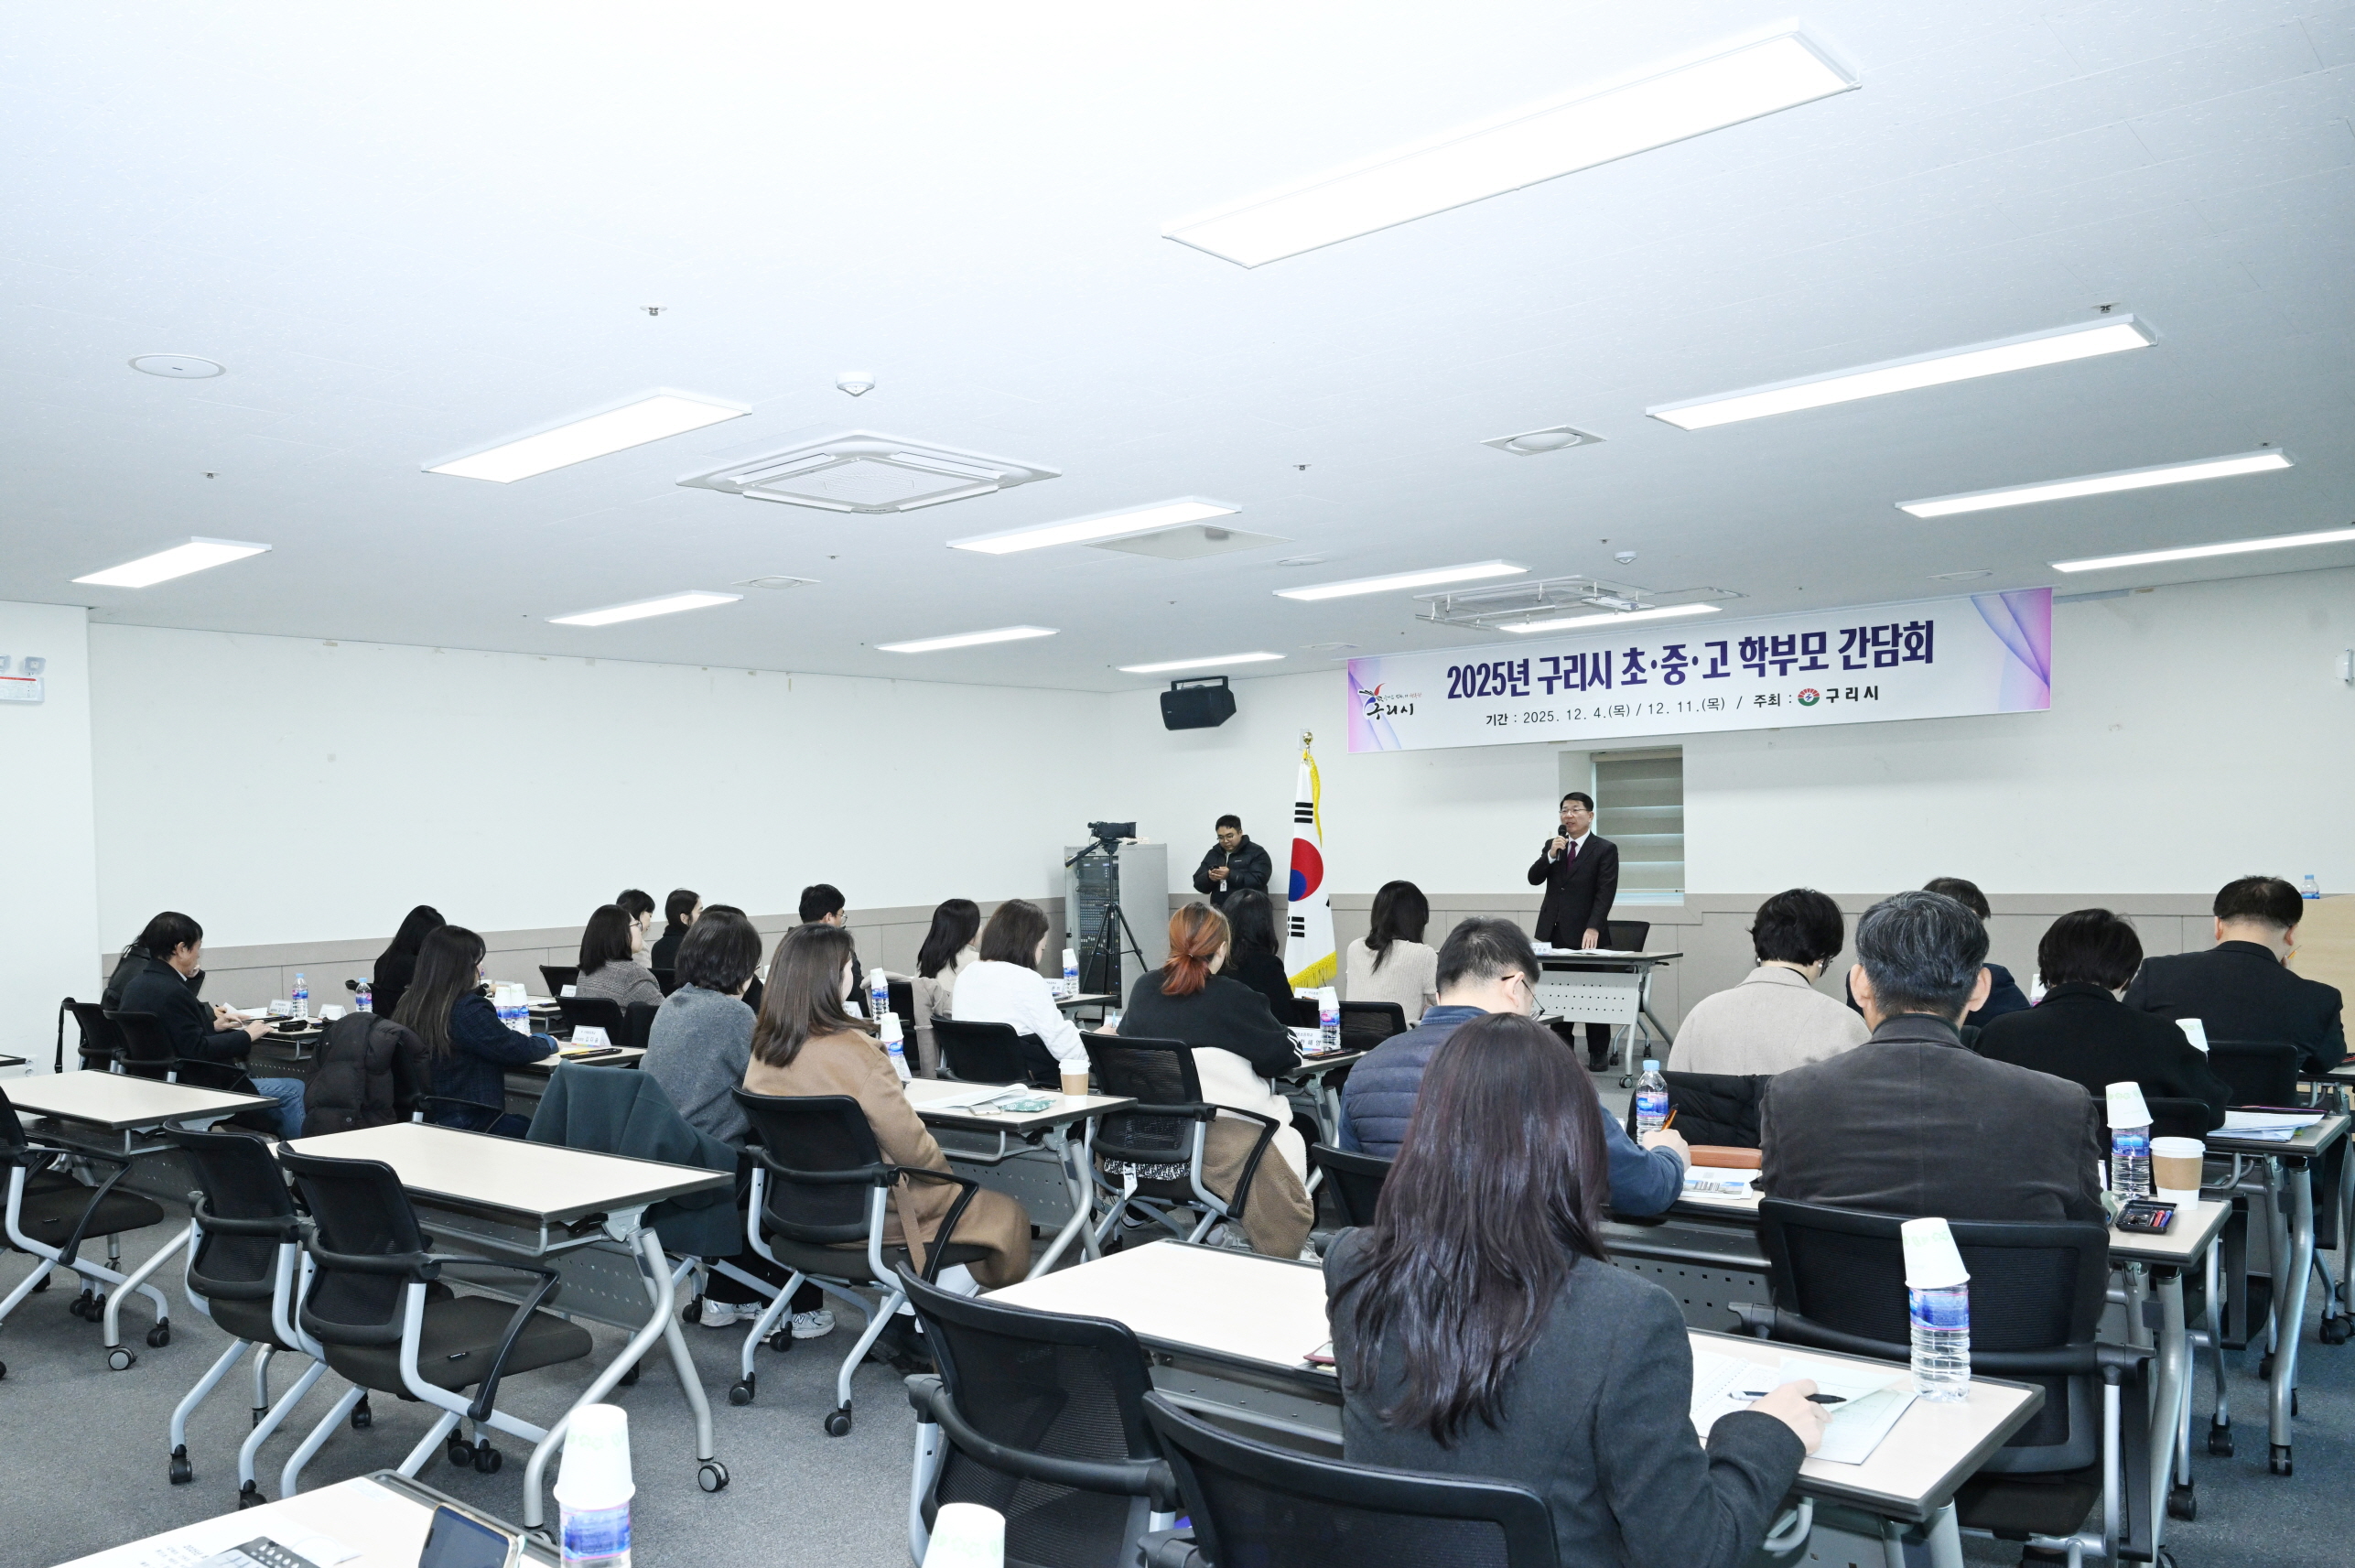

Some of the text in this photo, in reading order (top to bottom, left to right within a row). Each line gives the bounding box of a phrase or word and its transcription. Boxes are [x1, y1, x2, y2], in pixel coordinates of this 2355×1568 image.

[1447, 658, 1529, 699] 2025년
[1538, 650, 1612, 695] 구리시
[1738, 632, 1829, 677] 학부모
[1838, 620, 1934, 670] 간담회
[1485, 714, 1508, 726] 기간
[1523, 710, 1560, 723] 2025.
[1567, 708, 1587, 721] 12.
[1593, 704, 1630, 719] 4.(목)
[1648, 702, 1669, 715] 12.
[1677, 697, 1725, 713] 11.(목)
[1753, 693, 1781, 708] 주최
[794, 1314, 805, 1325] N
